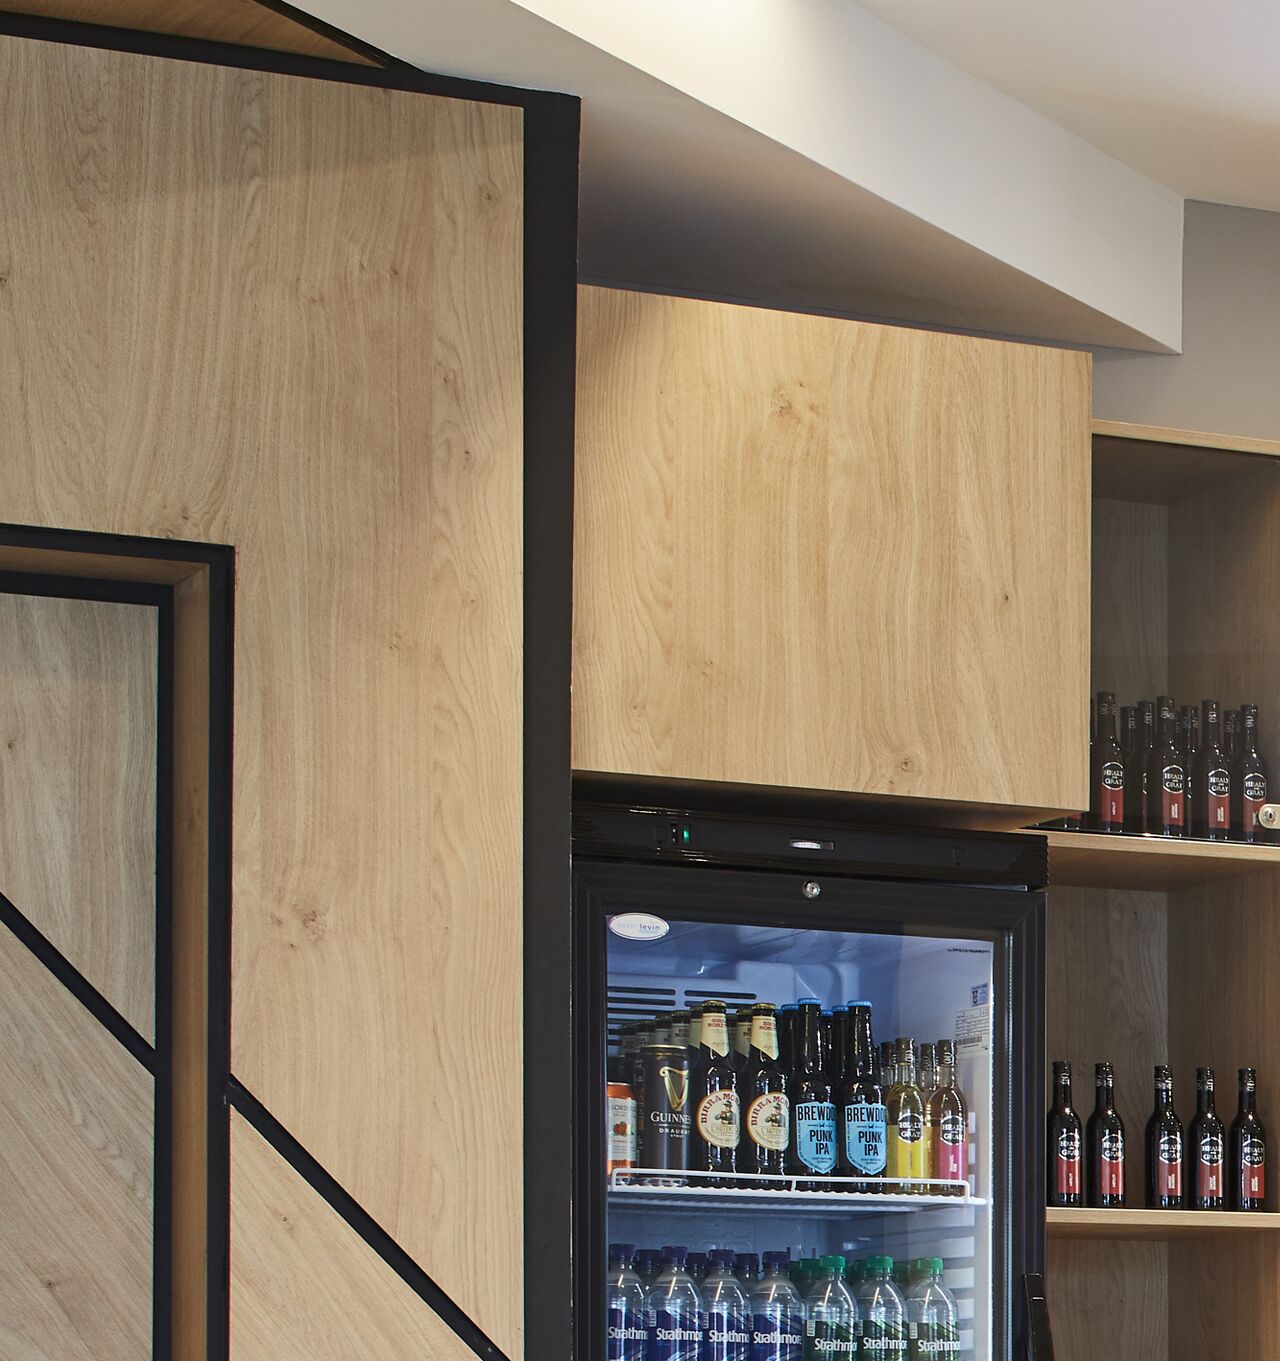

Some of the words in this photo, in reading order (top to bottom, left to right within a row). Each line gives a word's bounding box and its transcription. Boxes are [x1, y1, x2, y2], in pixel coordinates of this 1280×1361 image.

[1166, 781, 1183, 789] GRAY
[1211, 784, 1229, 792] GRAY
[1245, 780, 1266, 788] HEALY
[1246, 789, 1265, 797] GRAY
[809, 1129, 834, 1142] PUNK
[858, 1131, 883, 1143] PUNK
[815, 1142, 831, 1155] IPA
[864, 1144, 879, 1157] IPA
